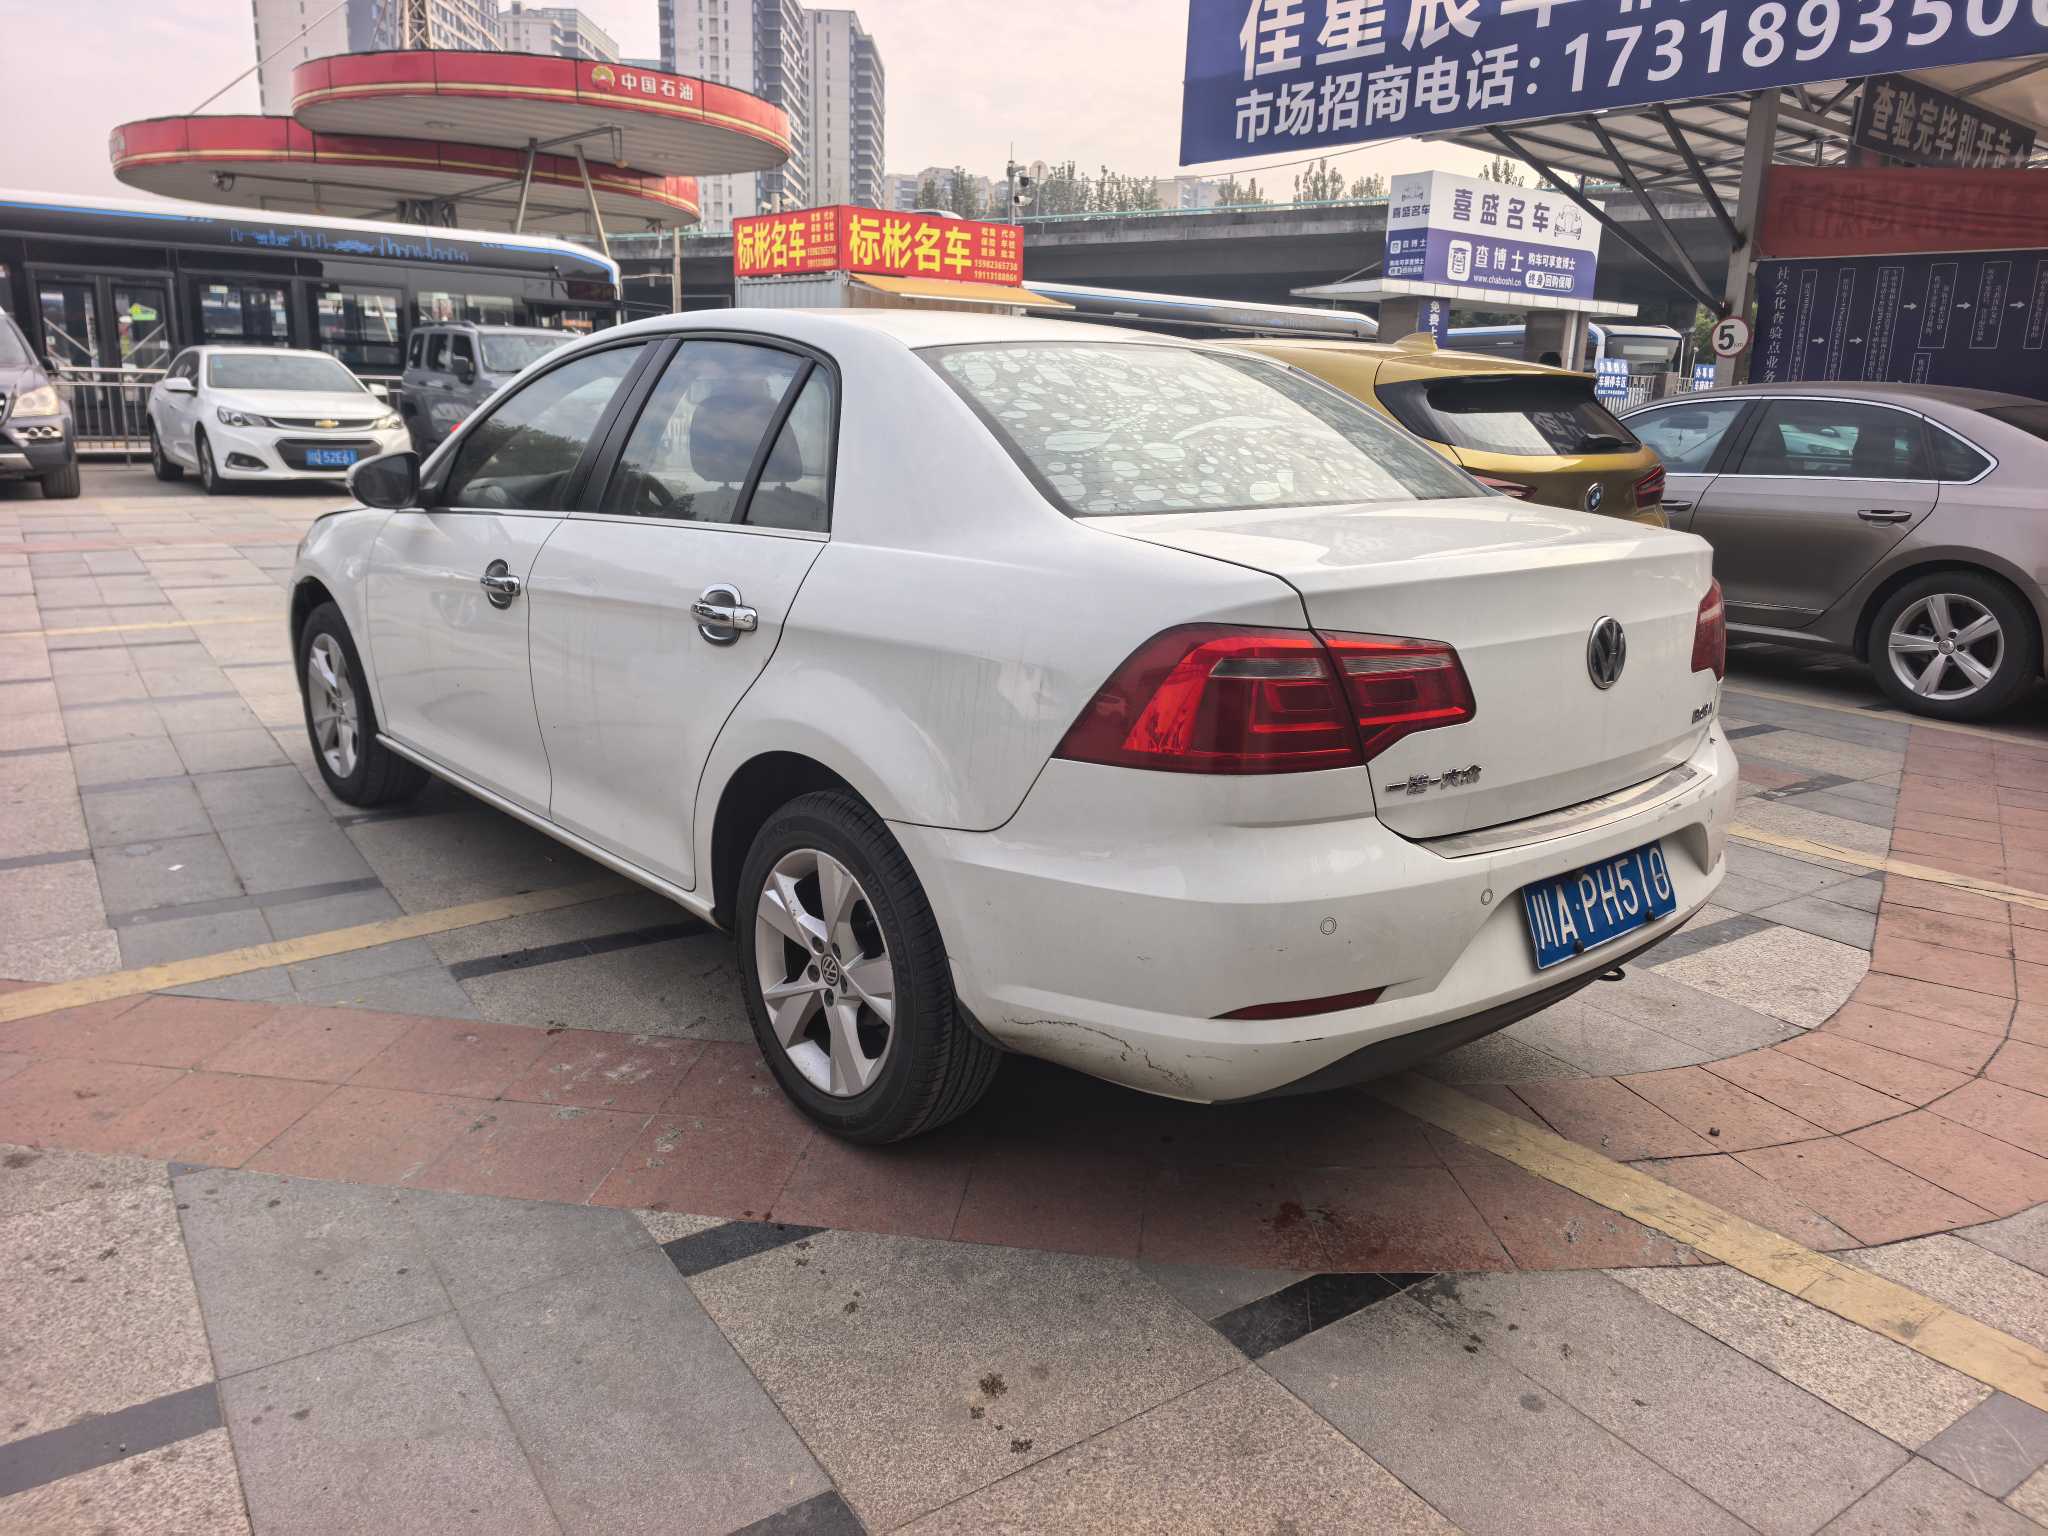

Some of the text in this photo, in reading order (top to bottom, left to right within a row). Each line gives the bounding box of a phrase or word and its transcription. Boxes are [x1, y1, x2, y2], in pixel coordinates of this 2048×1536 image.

[620, 72, 694, 101] 中国石油
[1453, 188, 1551, 233] 喜盛名车
[737, 217, 806, 270] 标彬名车
[849, 213, 972, 275] 标彬名车
[1475, 245, 1525, 273] 查博士
[1718, 325, 1736, 350] 5
[1598, 375, 1628, 388] 车辆停车区
